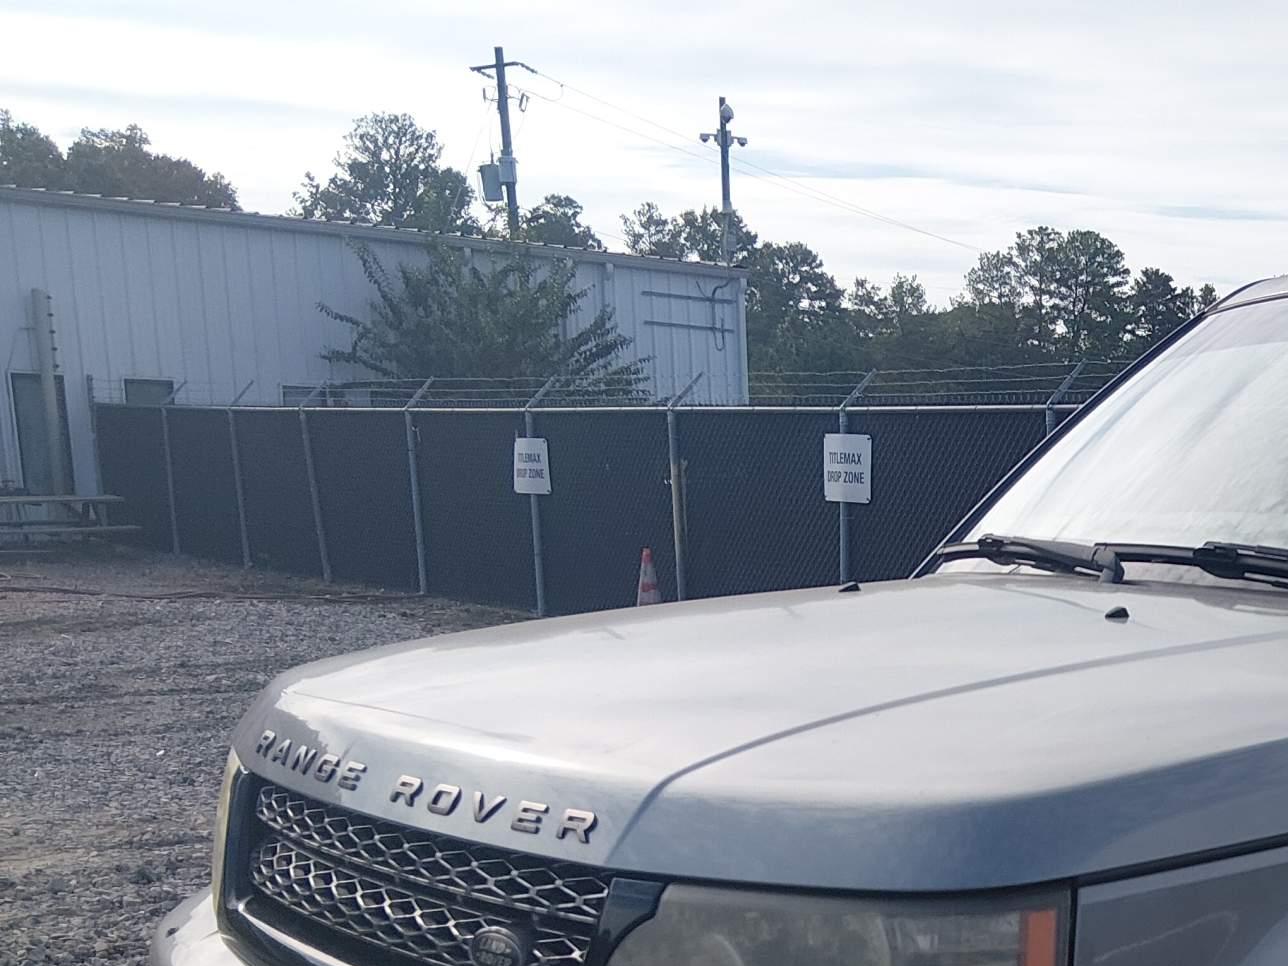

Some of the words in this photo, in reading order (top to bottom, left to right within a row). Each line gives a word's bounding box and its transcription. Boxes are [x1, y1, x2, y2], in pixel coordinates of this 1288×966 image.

[828, 451, 863, 465] TITLEMAX
[528, 468, 545, 479] ZONE
[827, 470, 842, 482] DROP
[843, 471, 866, 485] ZONE
[255, 729, 367, 791] RANGE
[390, 774, 600, 844] ROVER
